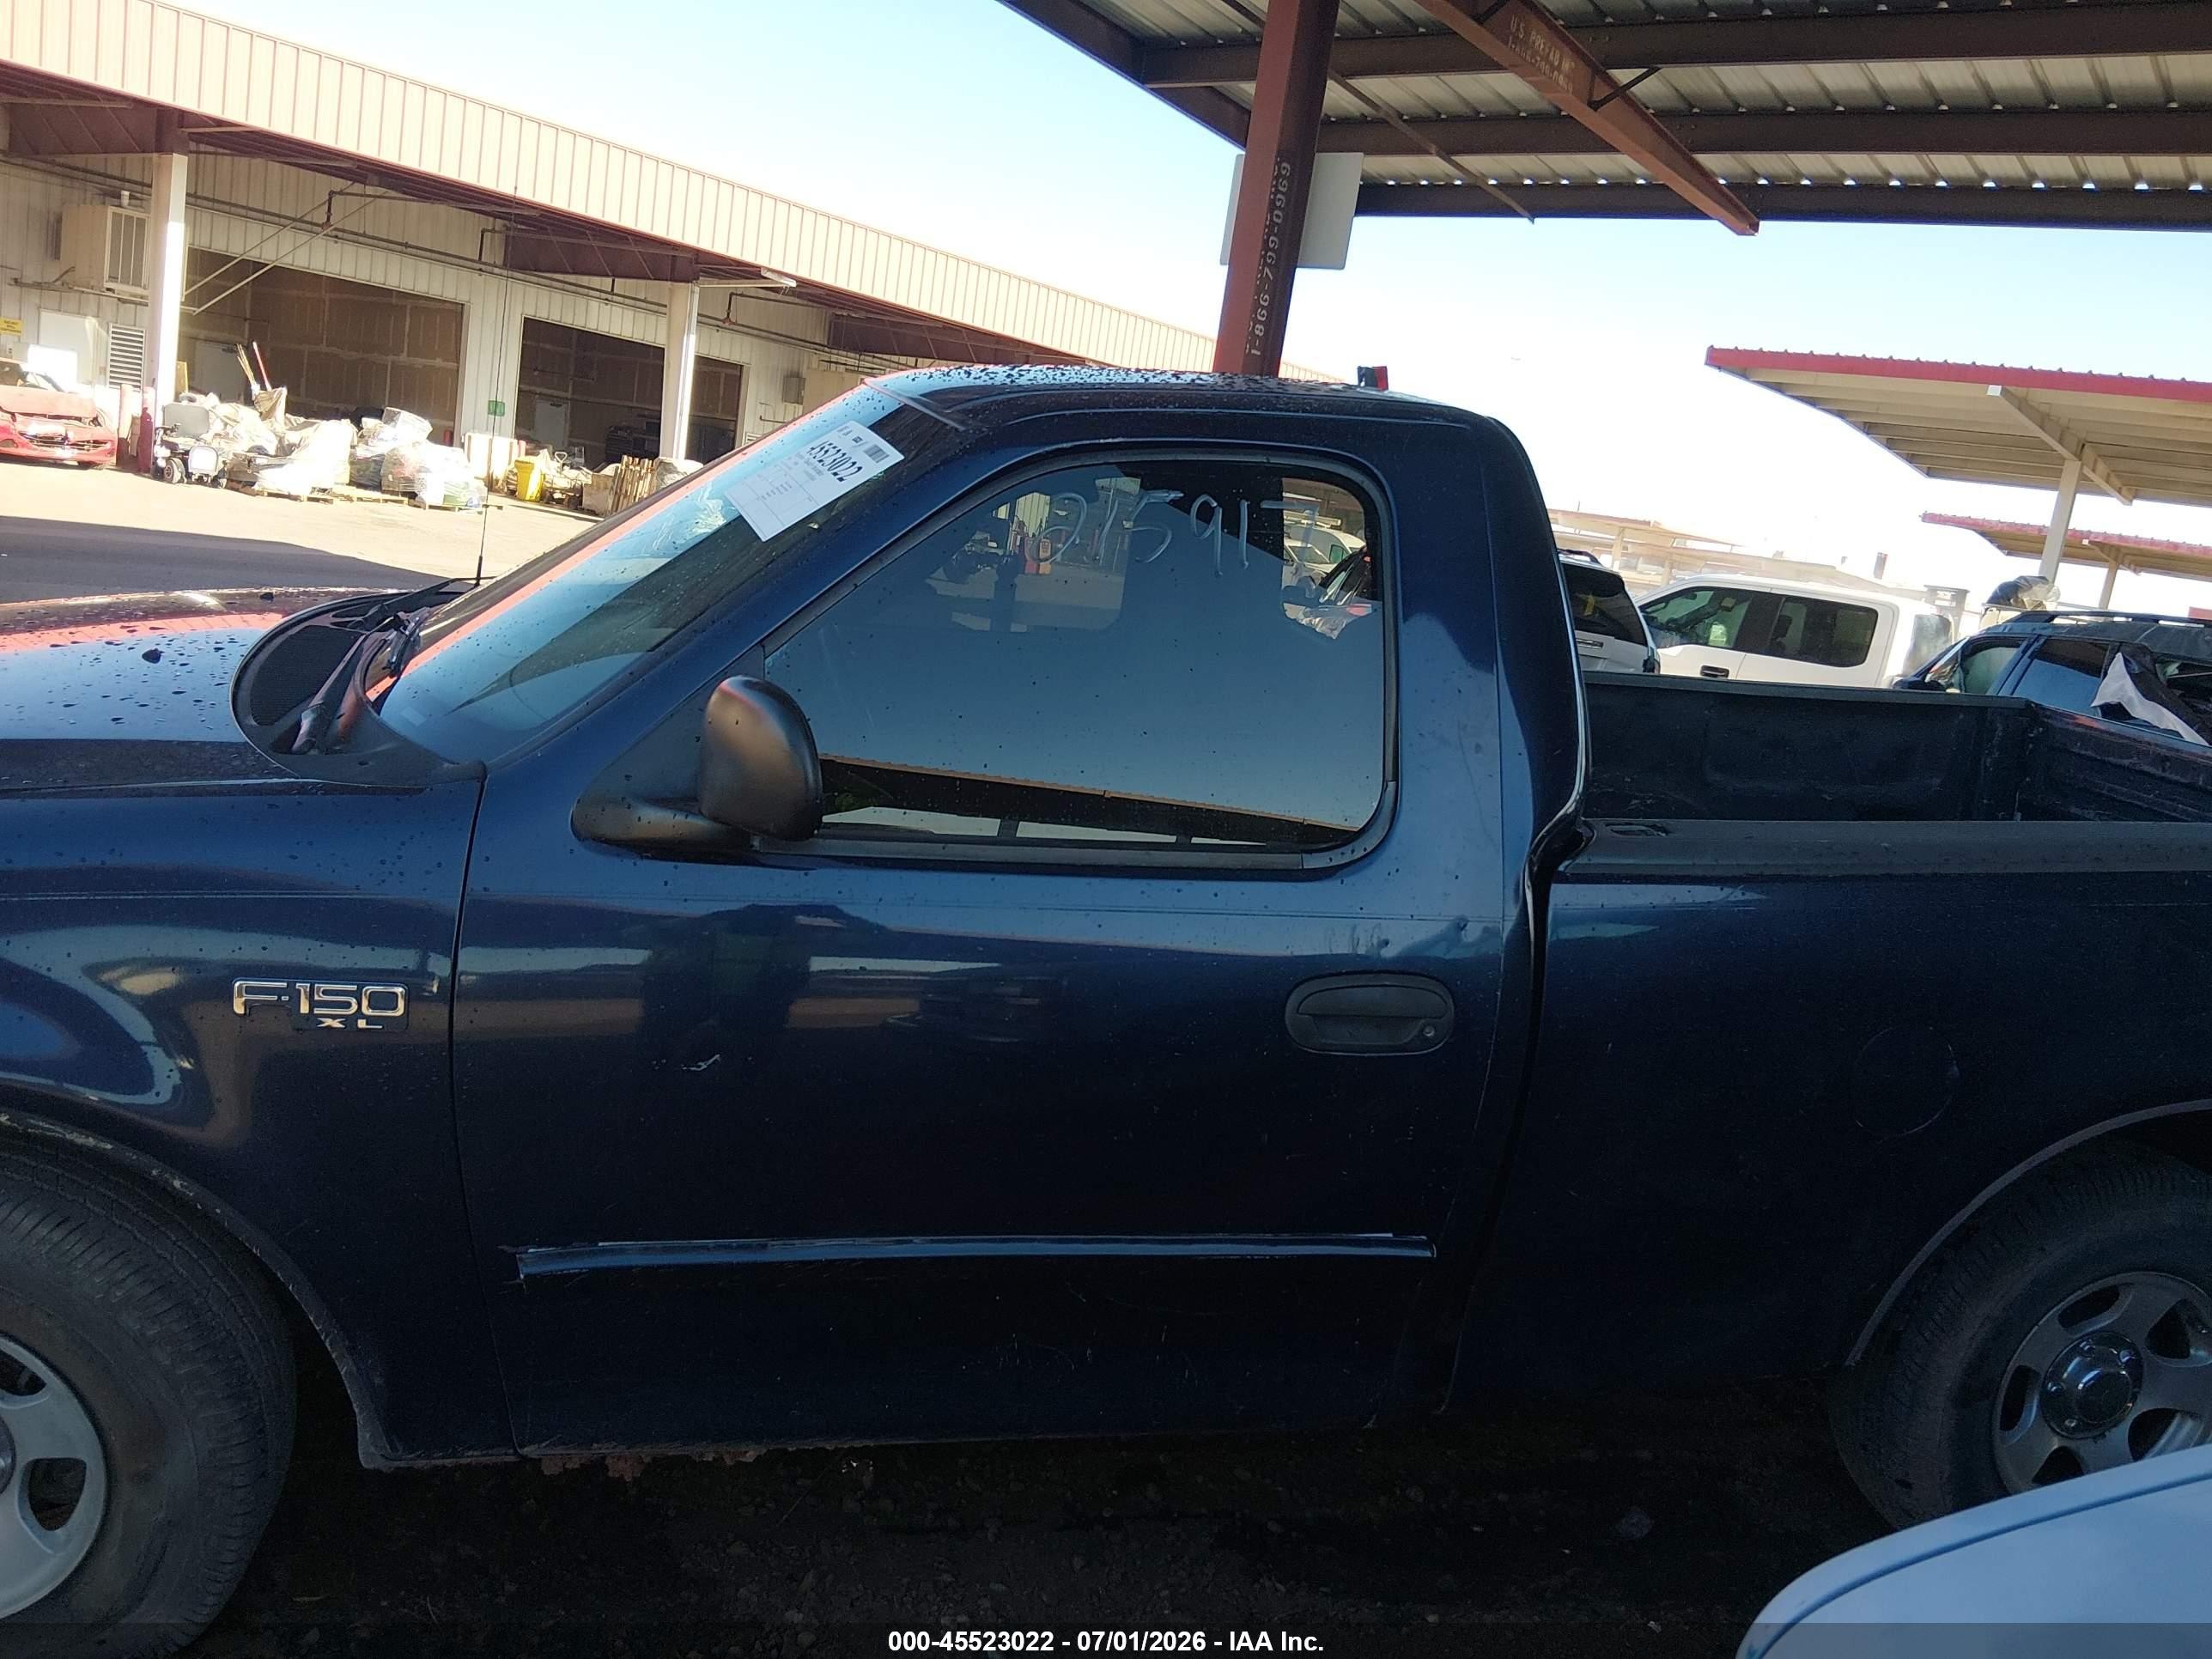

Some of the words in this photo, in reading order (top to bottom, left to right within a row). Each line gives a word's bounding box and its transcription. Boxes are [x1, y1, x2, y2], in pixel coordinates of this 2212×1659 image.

[1250, 161, 1291, 356] 1-866-799-0969
[805, 441, 863, 482] 45523022
[233, 981, 406, 1016] F-150
[317, 1018, 383, 1029] XL
